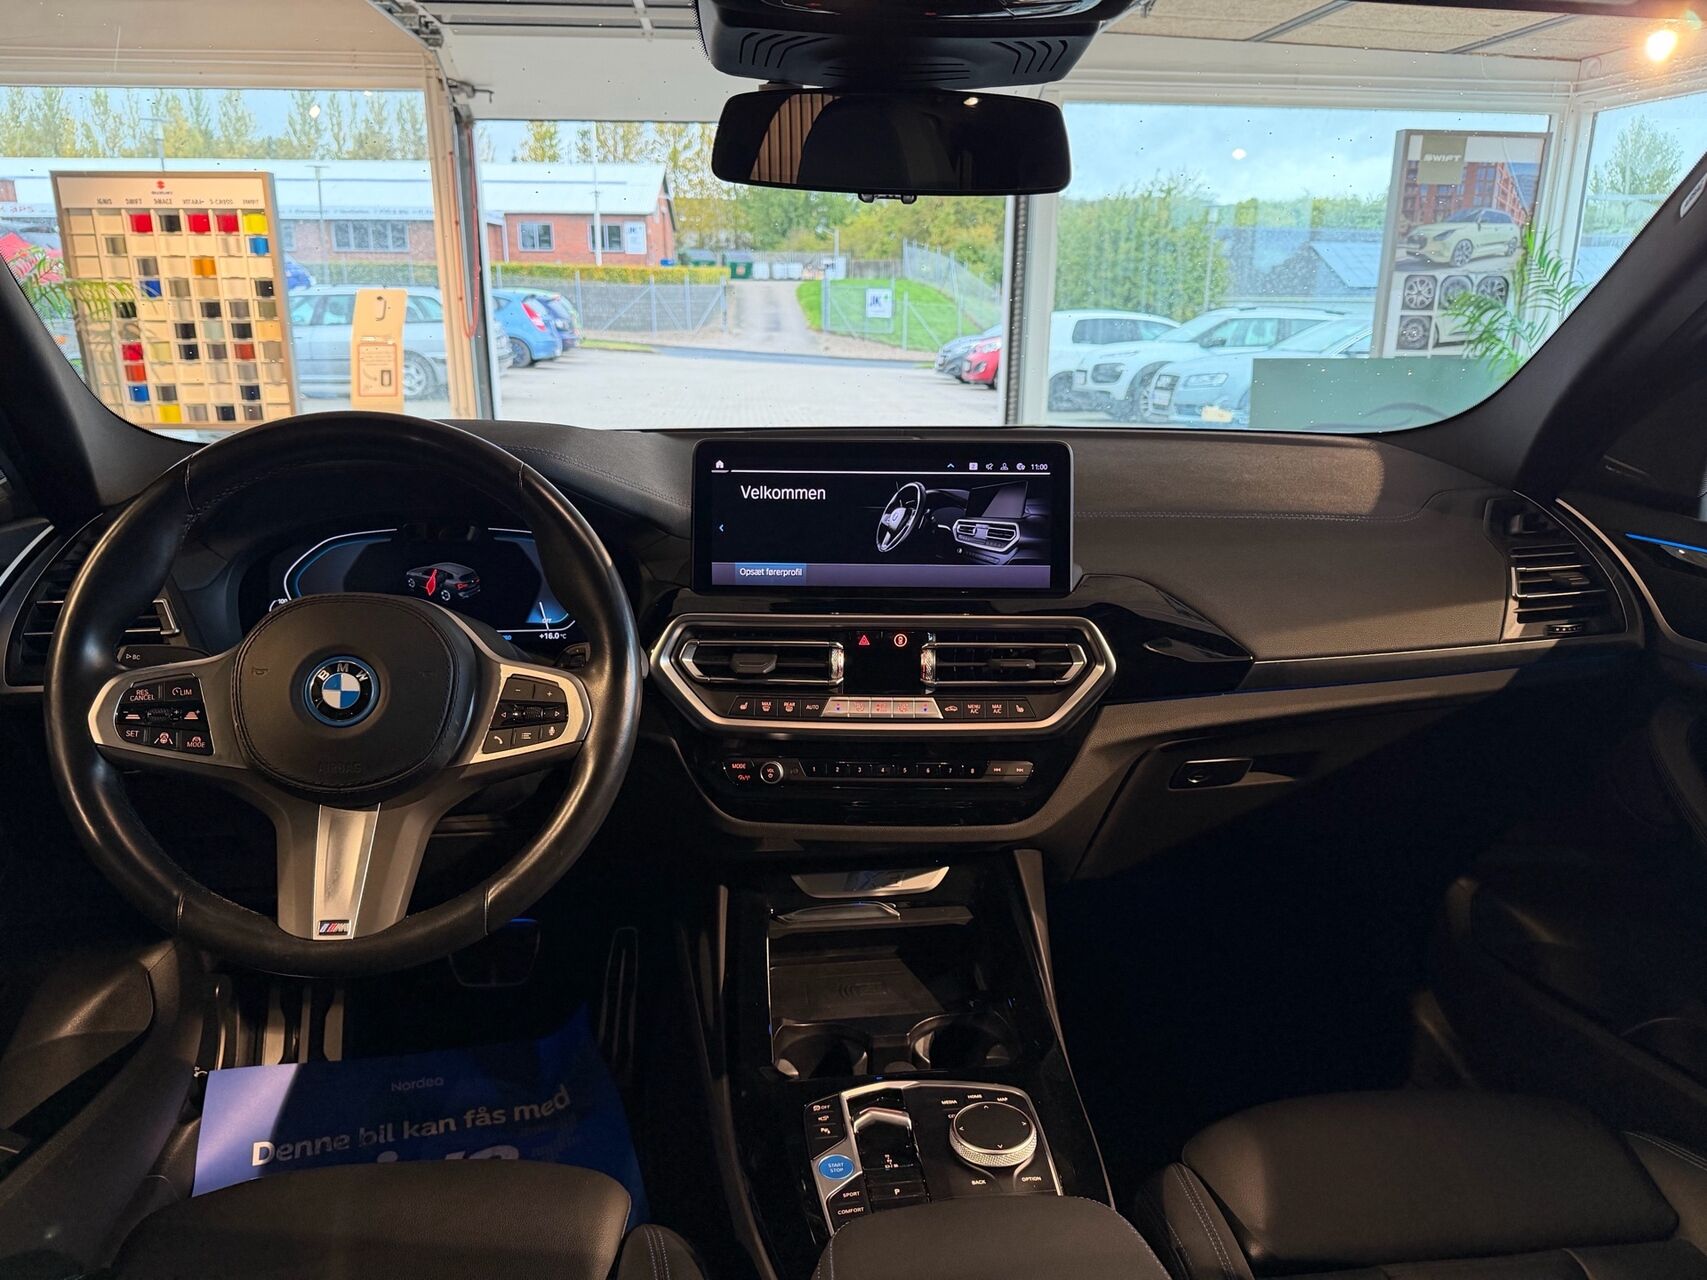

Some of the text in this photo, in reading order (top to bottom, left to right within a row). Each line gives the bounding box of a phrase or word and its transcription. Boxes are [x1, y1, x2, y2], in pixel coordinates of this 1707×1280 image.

[1423, 153, 1463, 162] SWIFT
[1030, 463, 1049, 471] 11:00
[740, 485, 827, 501] Velkommen
[739, 567, 803, 577] Opsæt førerprofil
[316, 663, 369, 682] BMW
[135, 688, 149, 696] RES
[180, 688, 193, 696] LIM
[125, 730, 140, 738] SET
[390, 1076, 445, 1092] Nordea
[250, 1132, 351, 1167] Denne
[358, 1120, 397, 1147] bil
[403, 1116, 457, 1140] kan
[464, 1106, 507, 1129] fås
[513, 1084, 571, 1121] med
[842, 1190, 861, 1198] SPORT
[893, 1188, 901, 1196] P
[837, 1206, 865, 1215] COMFORT
